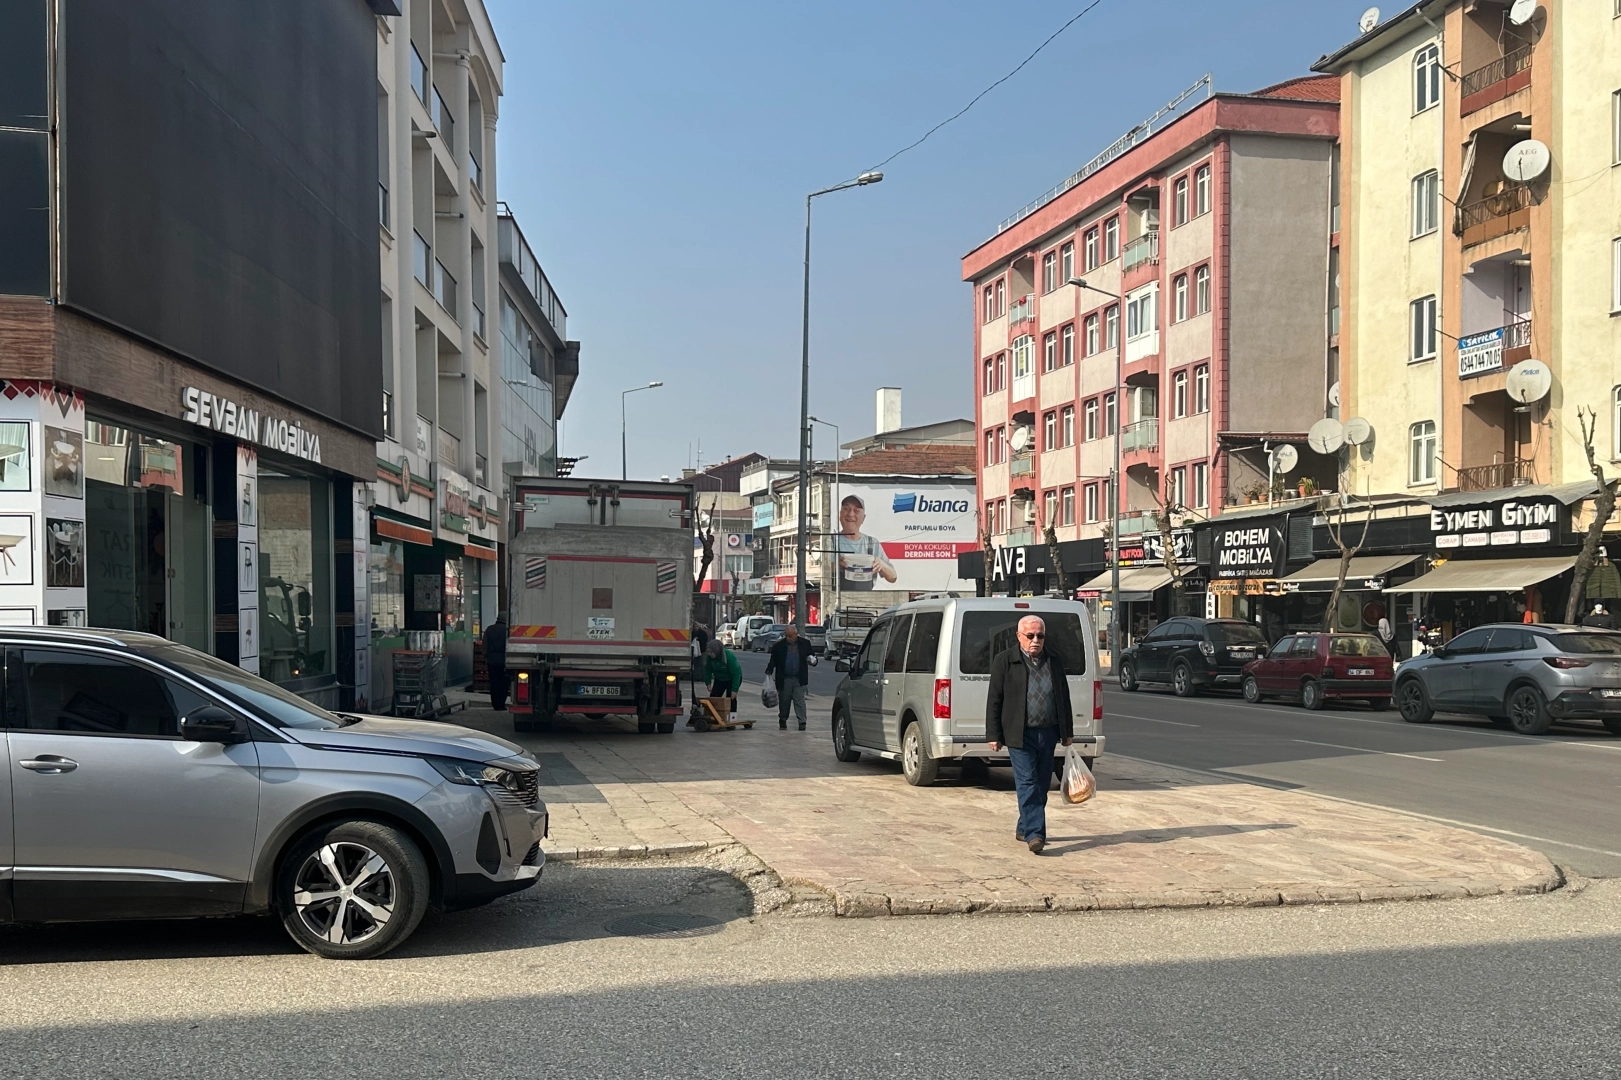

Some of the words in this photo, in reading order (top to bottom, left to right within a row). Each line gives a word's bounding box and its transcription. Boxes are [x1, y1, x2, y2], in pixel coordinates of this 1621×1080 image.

[182, 386, 259, 443] SEVBAN
[917, 494, 969, 513] bianca
[1430, 509, 1493, 532] EYMEN
[1224, 527, 1270, 547] BOHEM
[904, 543, 923, 551] BOYA
[924, 543, 951, 551] KOKUSU
[936, 550, 951, 558] SON
[992, 545, 1026, 582] Ava
[581, 686, 589, 694] 34
